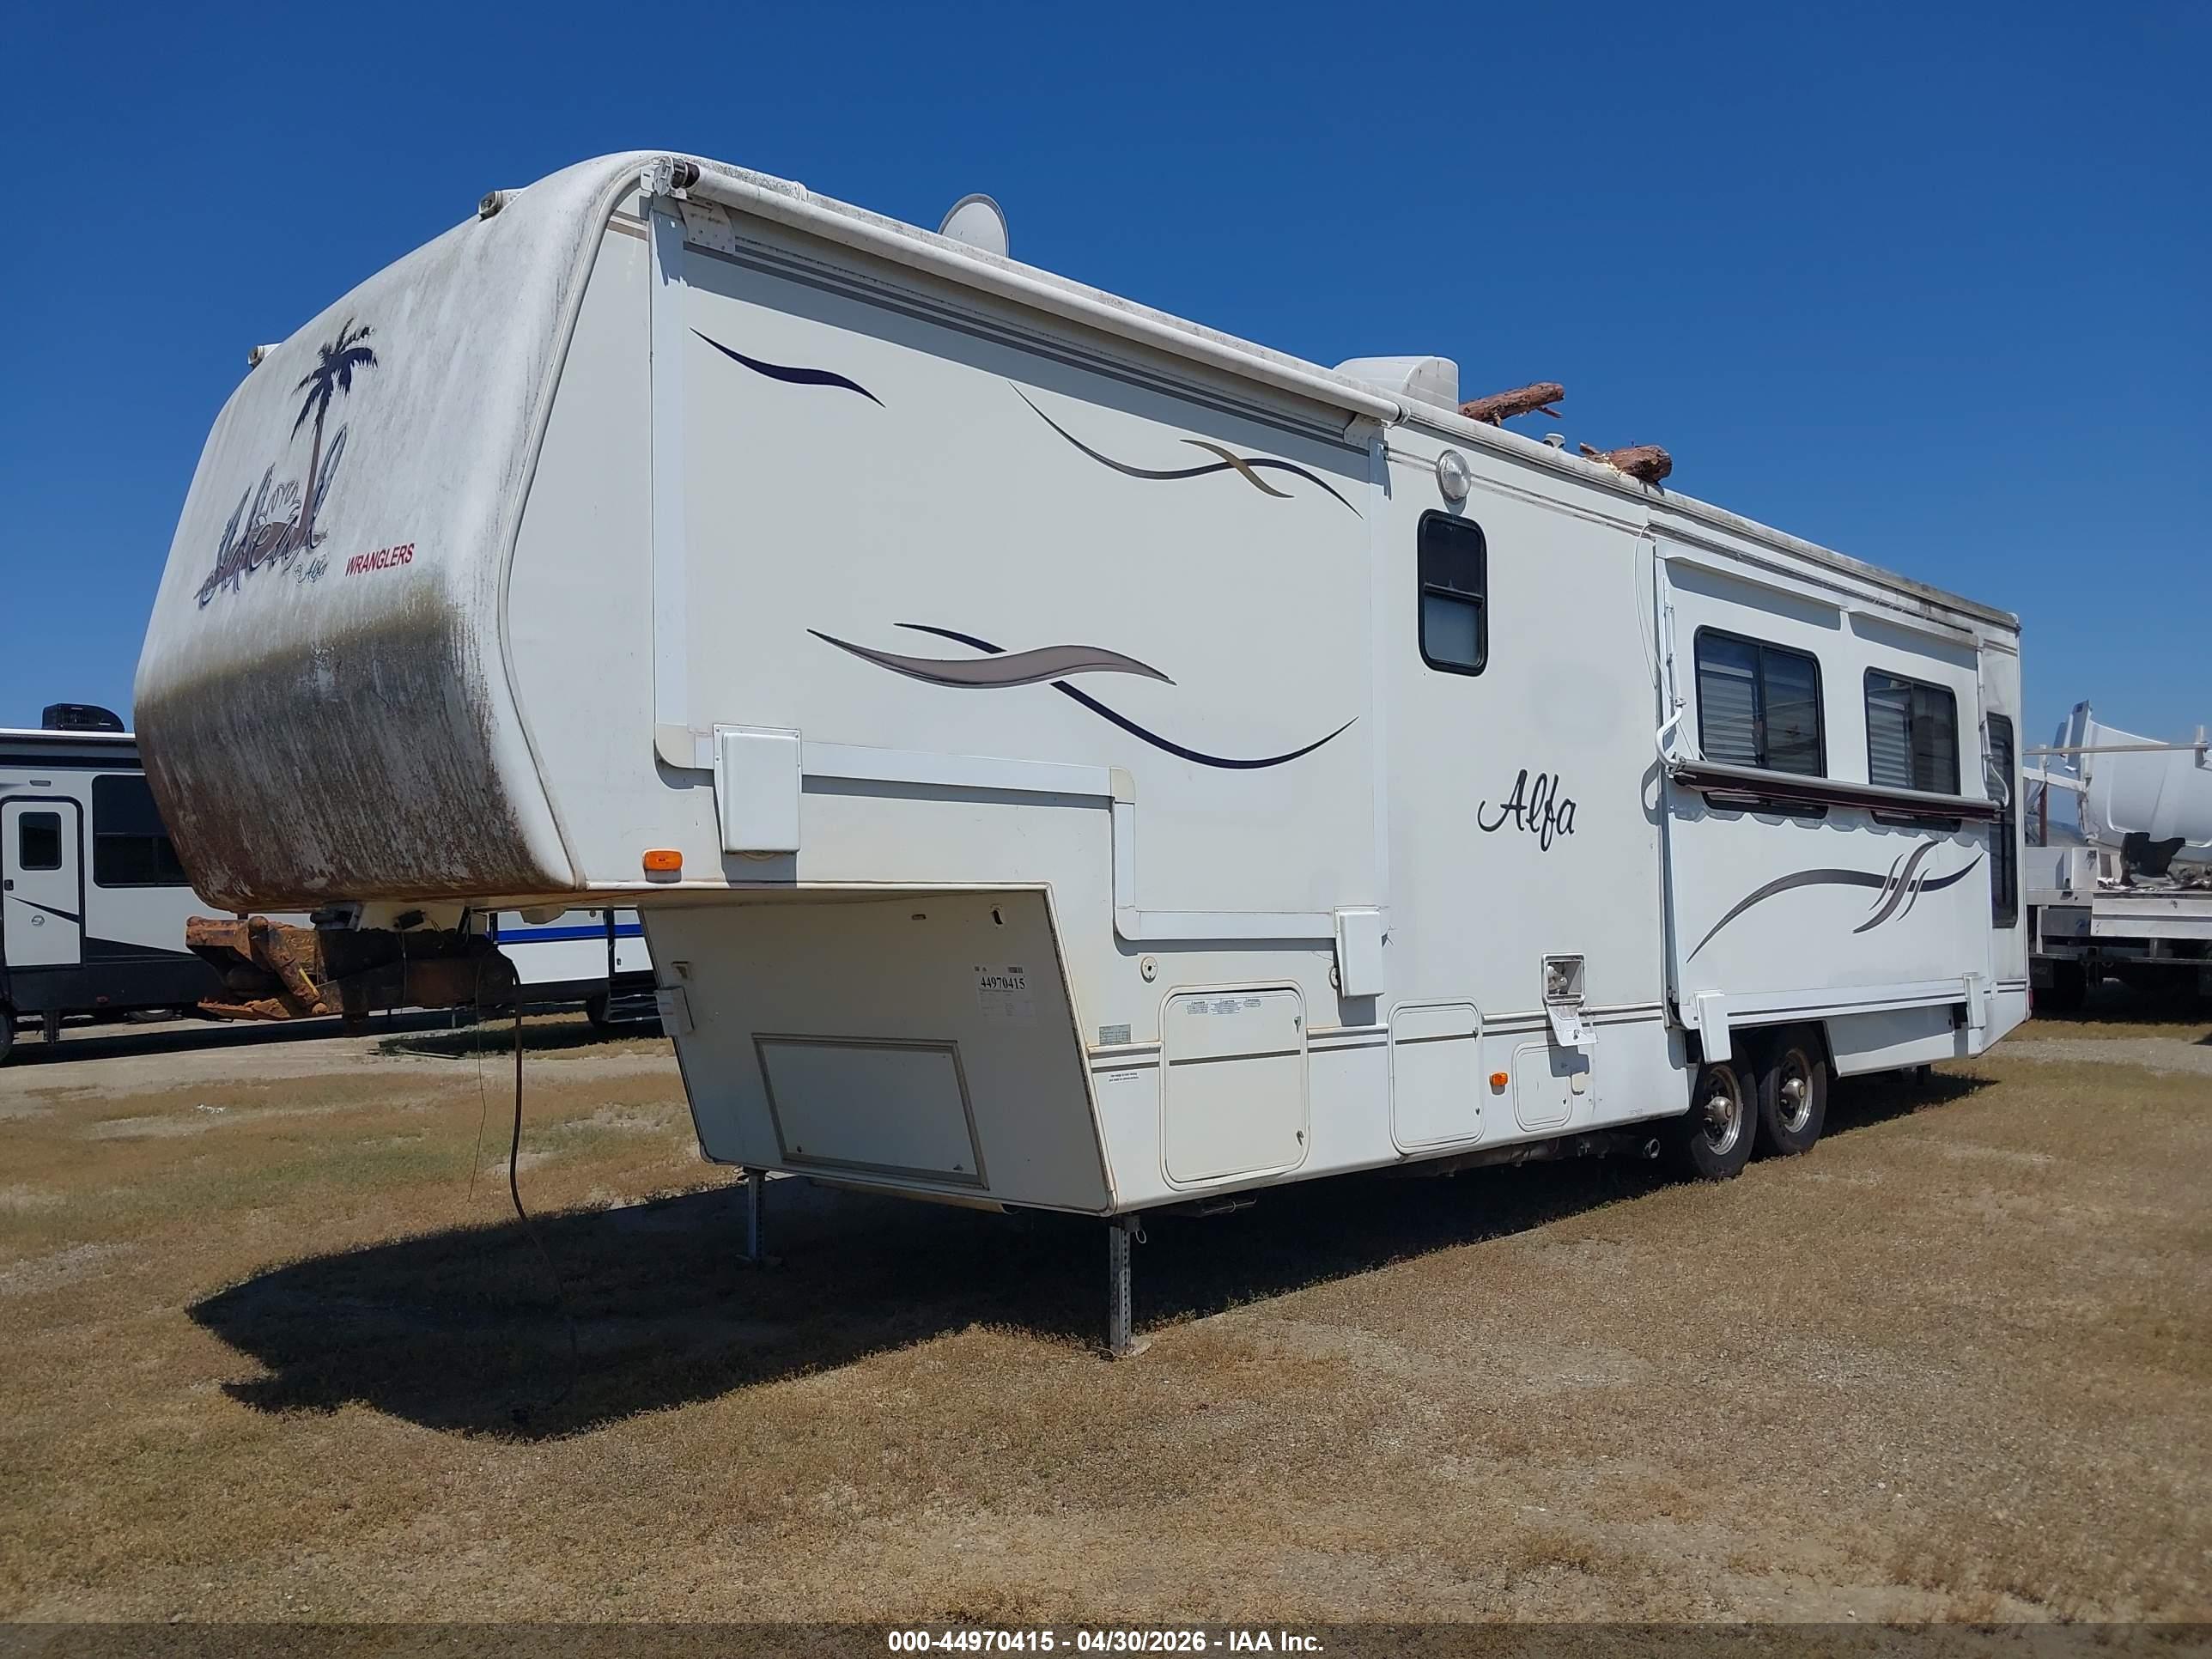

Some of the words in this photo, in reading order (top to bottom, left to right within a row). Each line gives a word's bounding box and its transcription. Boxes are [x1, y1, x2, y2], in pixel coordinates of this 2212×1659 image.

[346, 543, 415, 576] WRANGLERS
[1478, 769, 1577, 852] Alfa
[981, 975, 1025, 990] 44970415
